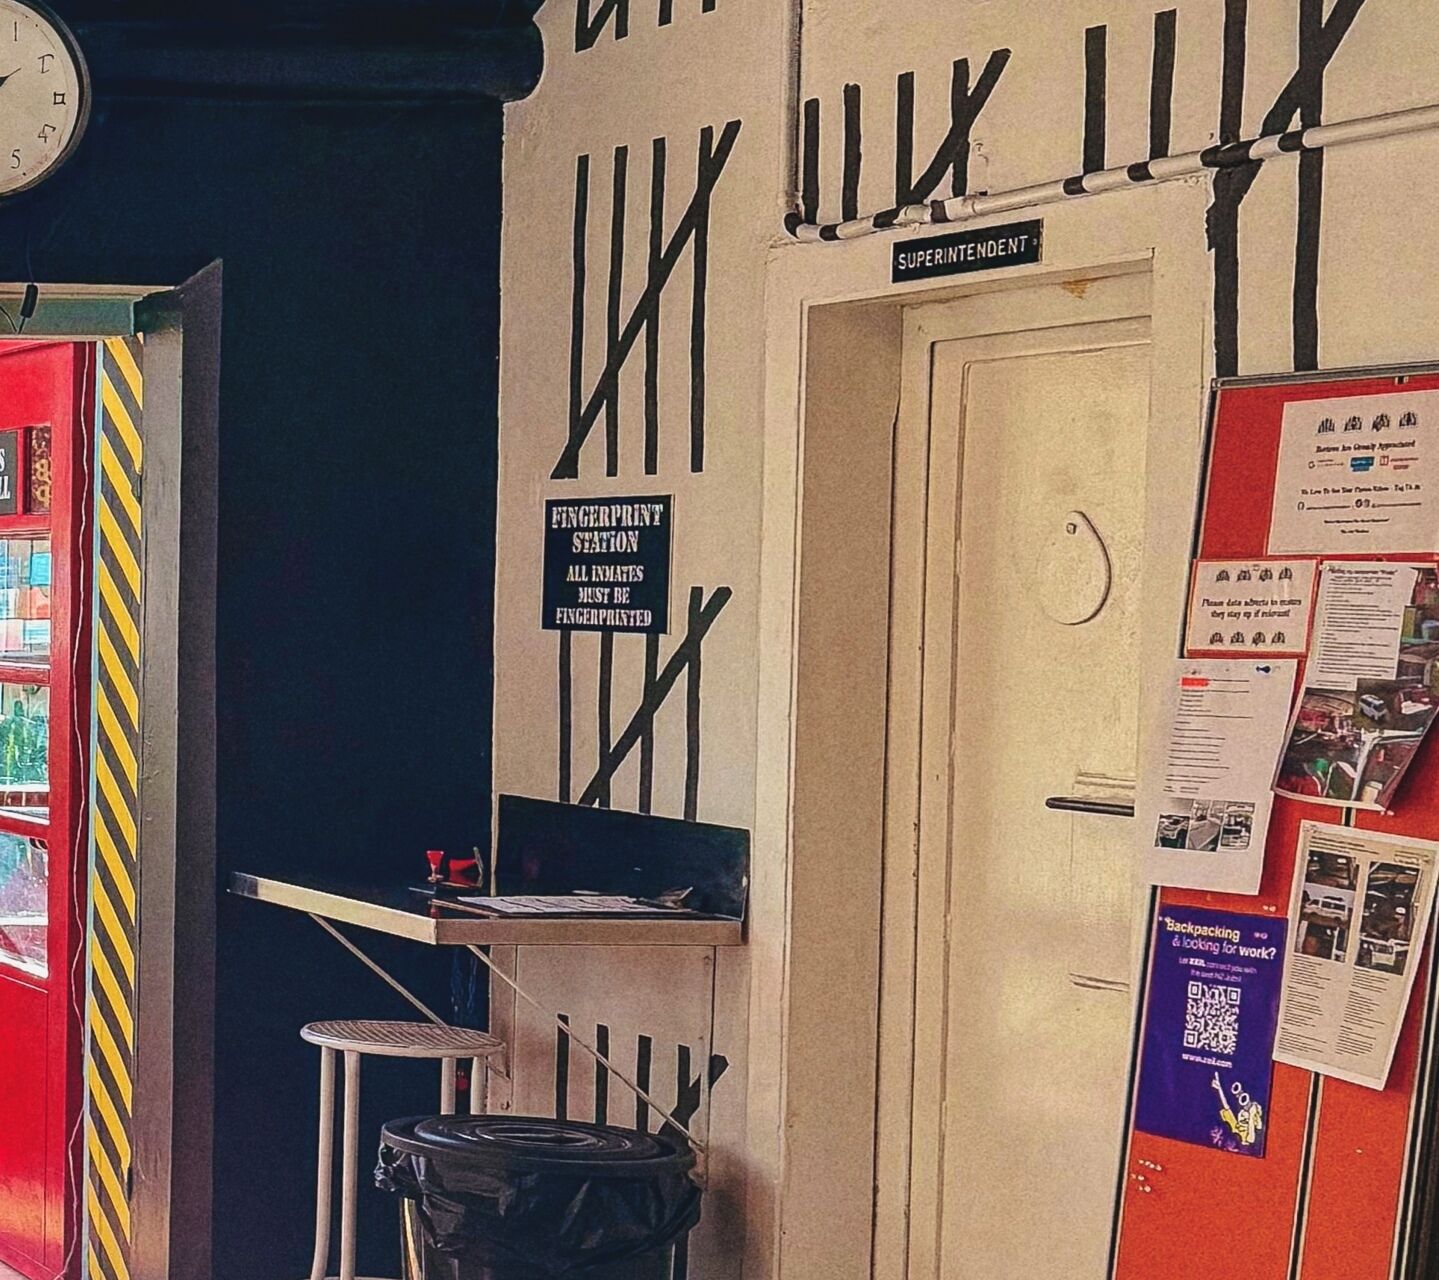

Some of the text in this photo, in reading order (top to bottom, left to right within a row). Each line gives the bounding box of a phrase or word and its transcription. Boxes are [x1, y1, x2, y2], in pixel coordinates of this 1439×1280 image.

[10, 148, 22, 170] 5
[898, 235, 1029, 270] SUPERINTENDENT
[551, 504, 664, 529] FINGERPRINT
[572, 531, 639, 554] STATION
[566, 565, 645, 582] ALL INMATES
[578, 587, 630, 604] MUST BE
[1202, 598, 1224, 607] Please
[555, 607, 652, 627] FINGERPRINTED
[1165, 919, 1241, 942] Backpacking
[1181, 935, 1220, 955] looking
[1221, 941, 1238, 954] for
[1238, 946, 1277, 960] work?
